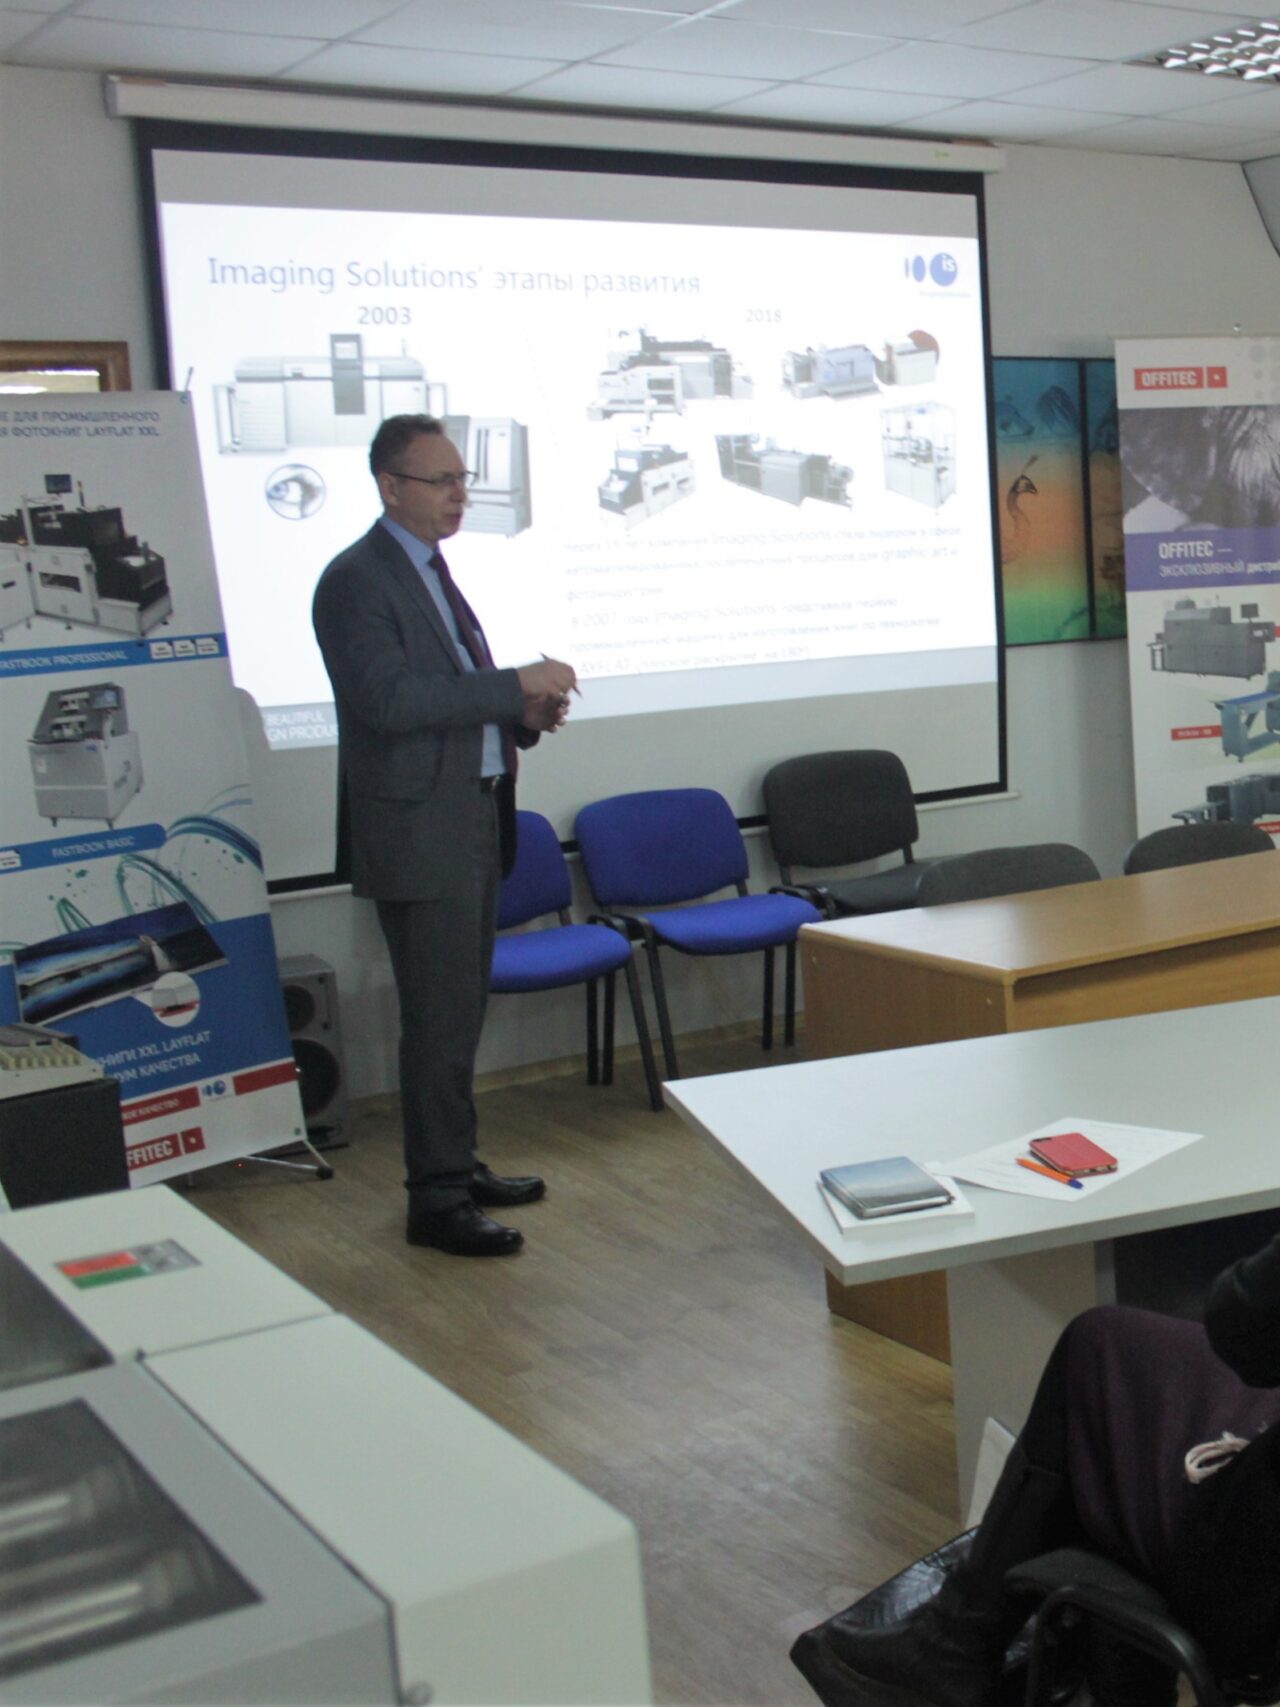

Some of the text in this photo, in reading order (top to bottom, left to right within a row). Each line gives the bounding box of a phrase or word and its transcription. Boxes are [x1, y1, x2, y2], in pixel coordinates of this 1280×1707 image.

[208, 257, 336, 294] Imaging
[493, 270, 575, 292] этапы
[583, 271, 701, 299] развития
[357, 305, 412, 326] 2003
[745, 308, 784, 324] 2018
[1141, 371, 1197, 388] OFFITEC
[1158, 541, 1214, 559] OFFITEC
[106, 835, 136, 850] BASIC
[127, 1140, 175, 1167] FFITEC
